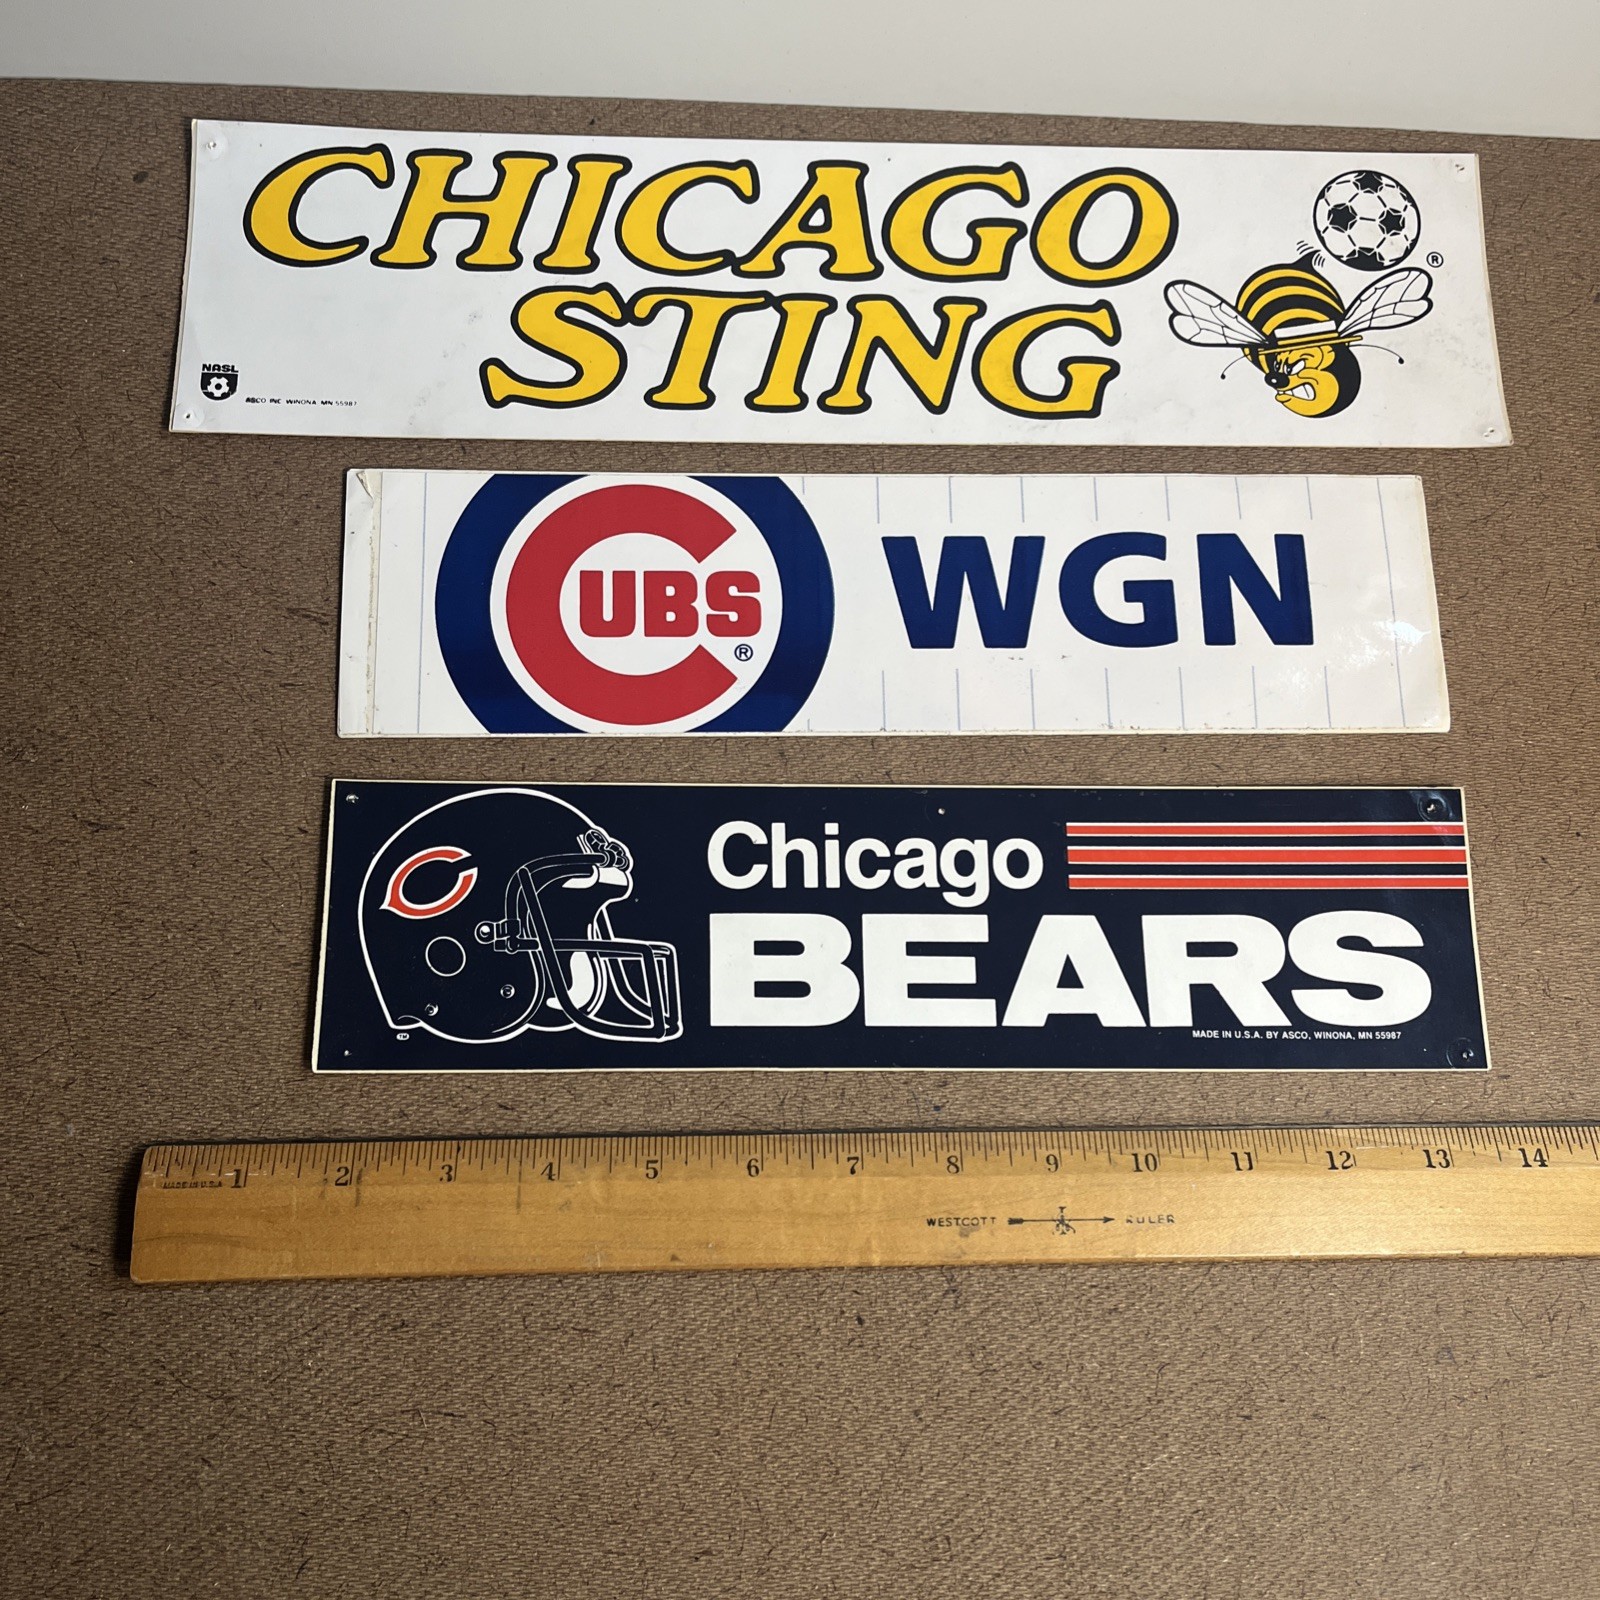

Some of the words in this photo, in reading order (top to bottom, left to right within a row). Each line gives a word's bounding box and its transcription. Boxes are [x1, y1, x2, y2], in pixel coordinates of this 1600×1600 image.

[243, 143, 1179, 288] CHICAGO
[201, 363, 239, 373] NASL
[479, 282, 1121, 419] STING
[881, 531, 1315, 649] WGN
[707, 820, 1044, 908] Chicago
[709, 910, 1433, 1028] BEARS
[1192, 1030, 1220, 1039] MADE
[1222, 1030, 1232, 1039] IN
[1234, 1030, 1263, 1039] U.S.A.
[1266, 1030, 1279, 1040] BY
[1282, 1030, 1311, 1041] ASCO,
[1313, 1031, 1356, 1041] WINONA,
[1358, 1031, 1373, 1040] MN
[1375, 1031, 1402, 1040] 55987
[230, 1168, 242, 1188] 1
[334, 1166, 350, 1186] 2
[439, 1164, 453, 1182] 3
[540, 1162, 556, 1181] 4
[645, 1160, 659, 1179] 5
[747, 1158, 760, 1177] 6
[846, 1156, 860, 1175] 7
[946, 1155, 960, 1174] 8
[1045, 1154, 1059, 1173] 9
[1132, 1153, 1158, 1172] 10
[1230, 1151, 1254, 1171] 11
[1326, 1150, 1352, 1170] 12
[1422, 1149, 1451, 1168] 13
[1518, 1148, 1549, 1167] 14
[926, 1216, 996, 1227] WESTCOTT
[1125, 1214, 1175, 1224] RULER
